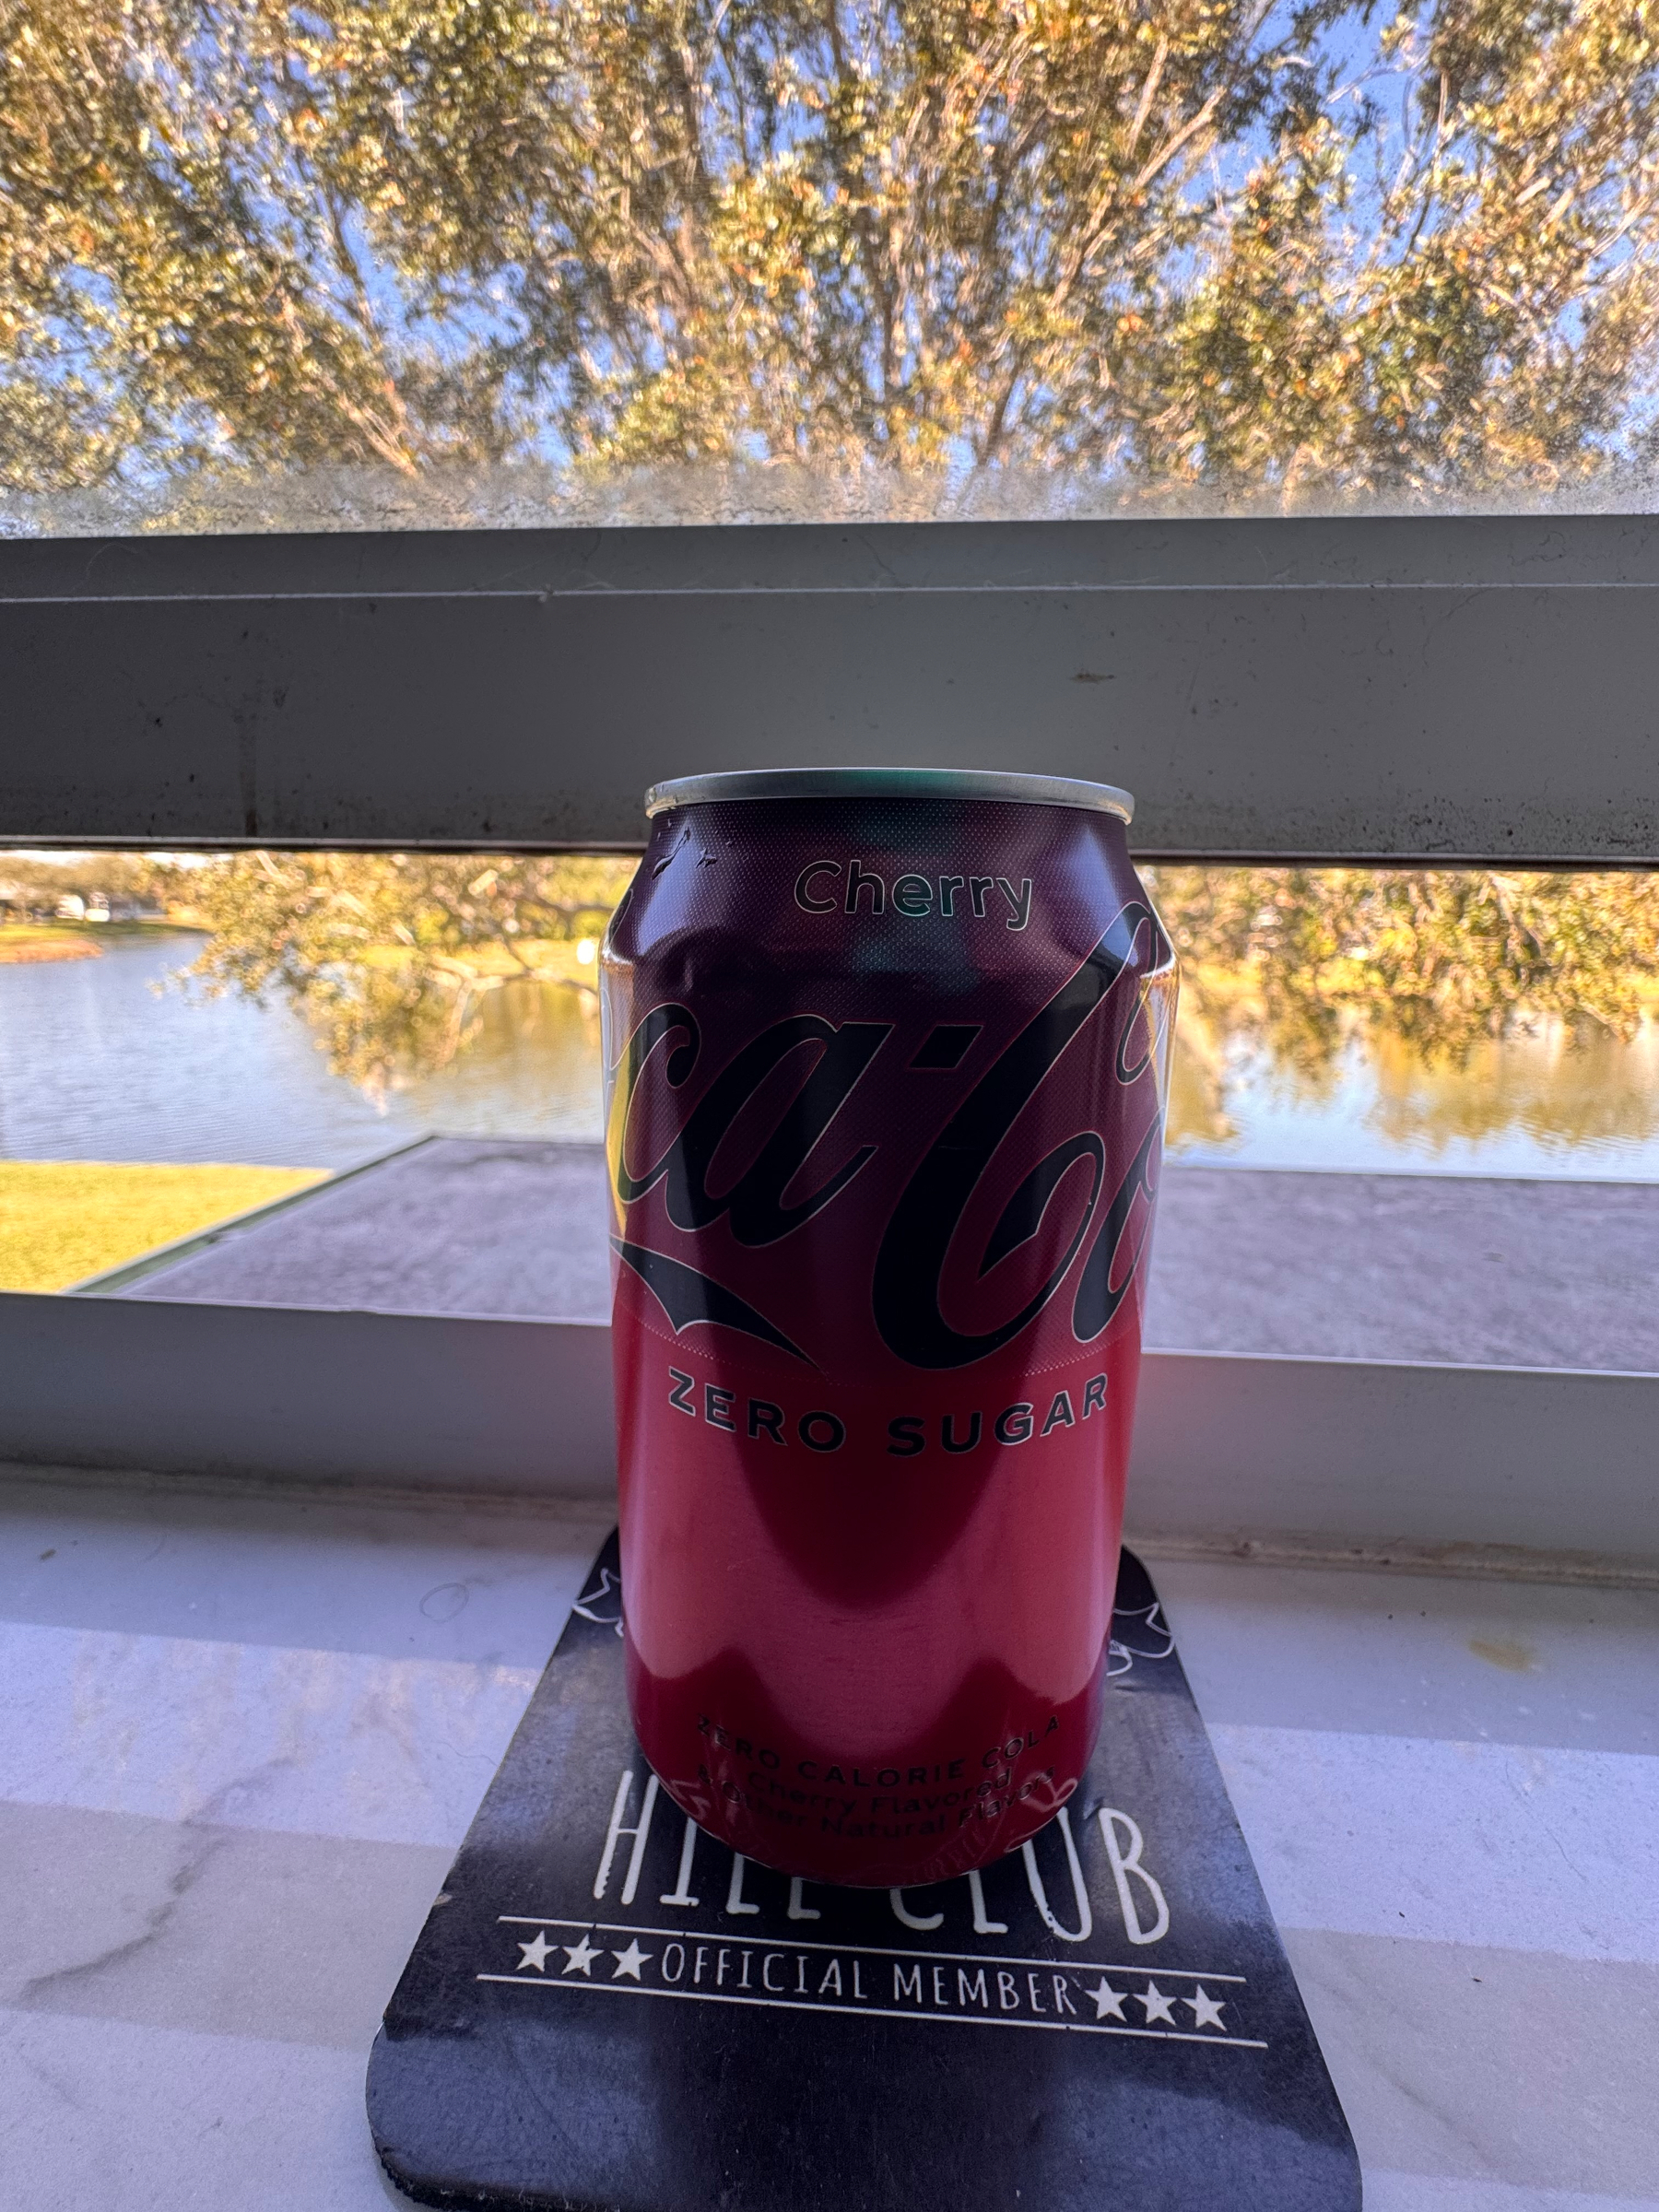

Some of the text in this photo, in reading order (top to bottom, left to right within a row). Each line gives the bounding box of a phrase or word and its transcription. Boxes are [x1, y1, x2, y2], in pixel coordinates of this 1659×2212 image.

[794, 859, 1033, 932] Cherry
[667, 1366, 1109, 1458] ZERO SUGAR
[697, 1712, 1059, 1788] ZERO CALORIE COLA
[723, 1780, 808, 1826] Other
[821, 1814, 946, 1839] Natural
[959, 1766, 1055, 1828] Flavors
[747, 1766, 1012, 1818] Cherry Flavored
[661, 1942, 1077, 2016] OFFICIAL MEMBER
